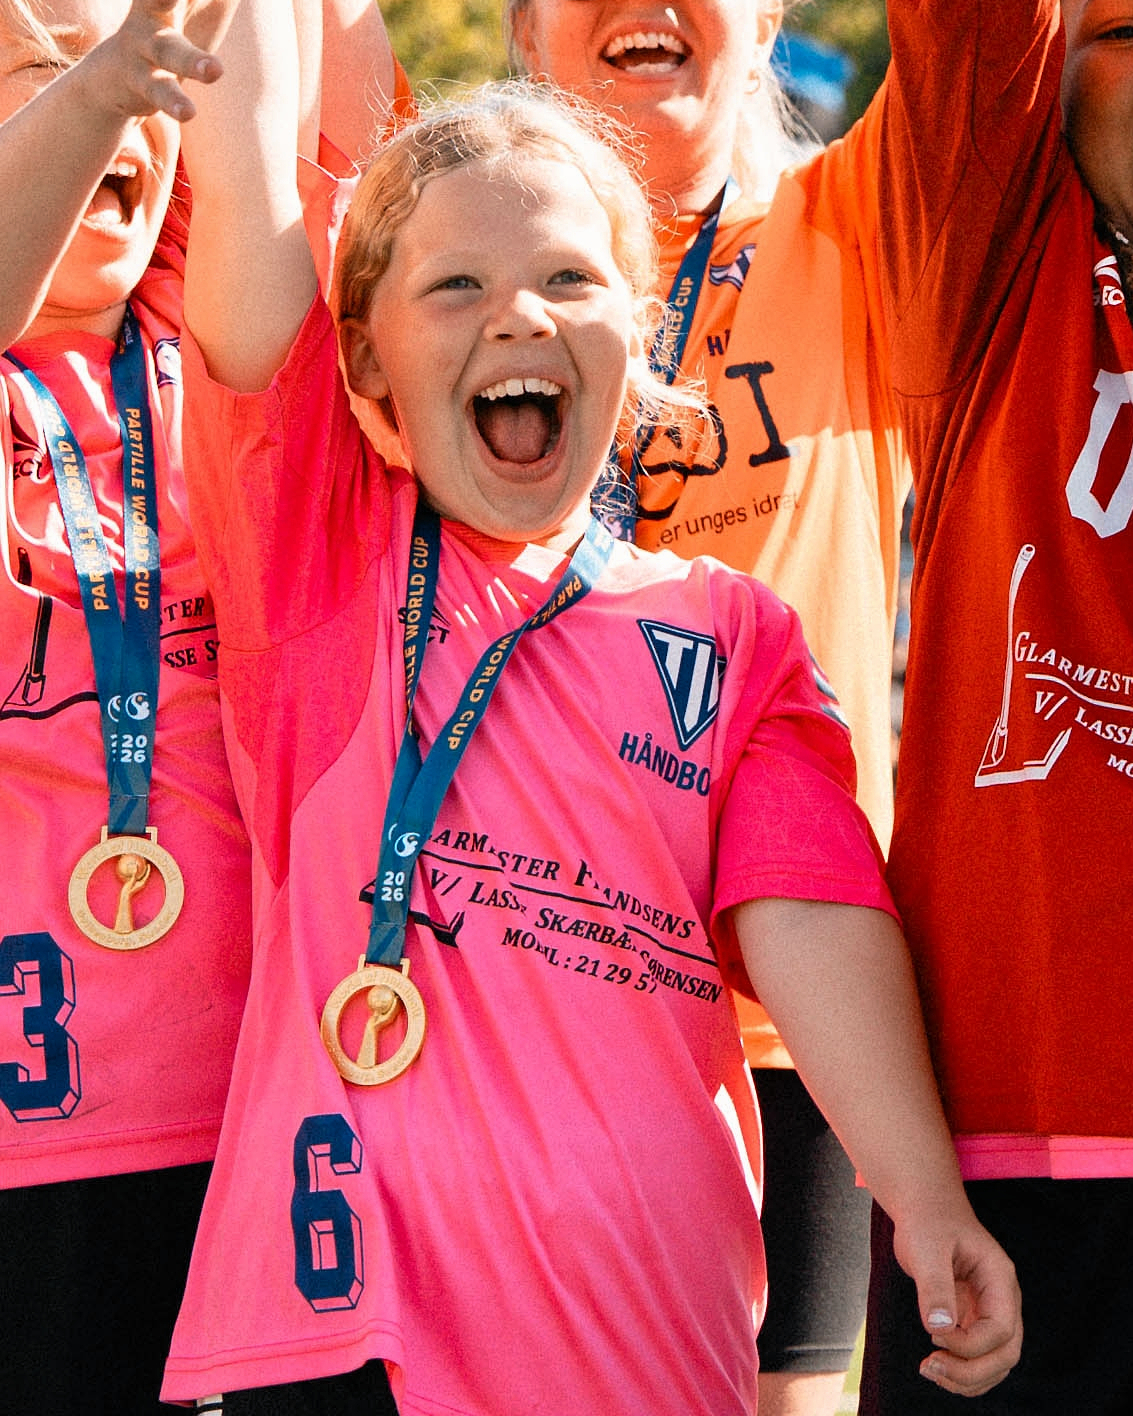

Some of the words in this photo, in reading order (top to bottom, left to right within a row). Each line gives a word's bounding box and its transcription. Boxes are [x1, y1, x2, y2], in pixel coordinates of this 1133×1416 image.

[125, 407, 145, 490] PARTILLE
[131, 495, 149, 562] WORLD
[685, 506, 748, 535] unges
[413, 536, 429, 569] CUP
[134, 568, 150, 610] CUP
[405, 572, 427, 641] WORLD
[469, 634, 515, 703] WORLD
[1034, 690, 1069, 721] V/
[122, 734, 148, 749] 20
[447, 709, 475, 751] CUP
[120, 749, 146, 763] 26
[380, 886, 405, 902] 26
[383, 870, 406, 887] 20
[430, 868, 463, 897] V/
[574, 955, 600, 977] 21
[603, 963, 633, 985] 29
[291, 1113, 365, 1315] 6
